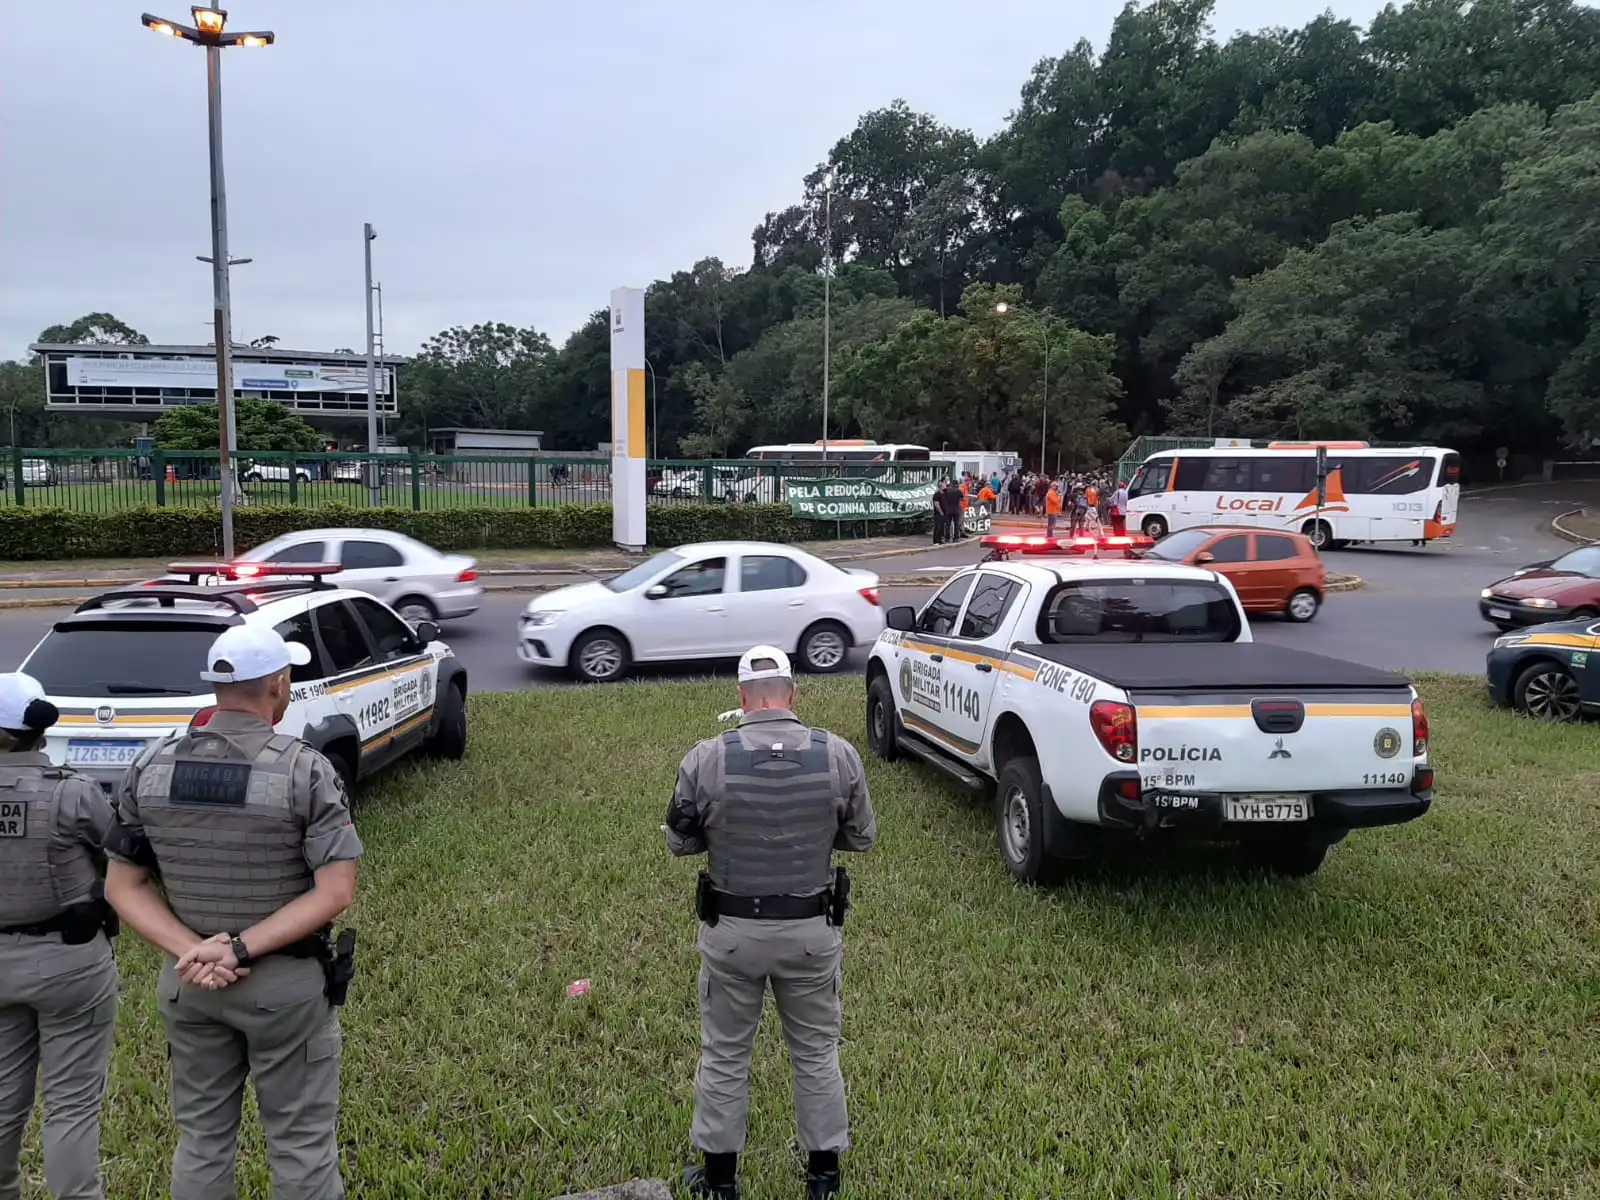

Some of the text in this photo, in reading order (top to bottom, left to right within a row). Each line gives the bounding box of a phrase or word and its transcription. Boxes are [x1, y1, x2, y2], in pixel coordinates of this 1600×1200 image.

[789, 486, 820, 498] PELA
[825, 482, 872, 499] REDUÇÃO
[799, 502, 814, 513] DE
[817, 502, 869, 515] COZINHA,
[869, 501, 895, 513] DIESEL
[964, 506, 976, 518] ER
[1215, 495, 1283, 512] Local
[1392, 502, 1423, 512] 1013
[964, 518, 991, 532] NDER
[912, 660, 941, 682] BRIGADA
[394, 679, 418, 699] BRIGADA
[912, 676, 940, 698] MILITAR
[1035, 662, 1097, 705] FONE 190
[289, 684, 324, 702] ONE 190
[394, 692, 418, 710] MILITAR
[943, 680, 980, 722] 11140
[359, 698, 390, 731] 11982
[73, 747, 136, 762] IZG3E69
[1140, 744, 1222, 762] POLÍCIA
[1165, 774, 1196, 786] BPM
[1362, 772, 1405, 784] 11140
[1172, 796, 1199, 808] BPM
